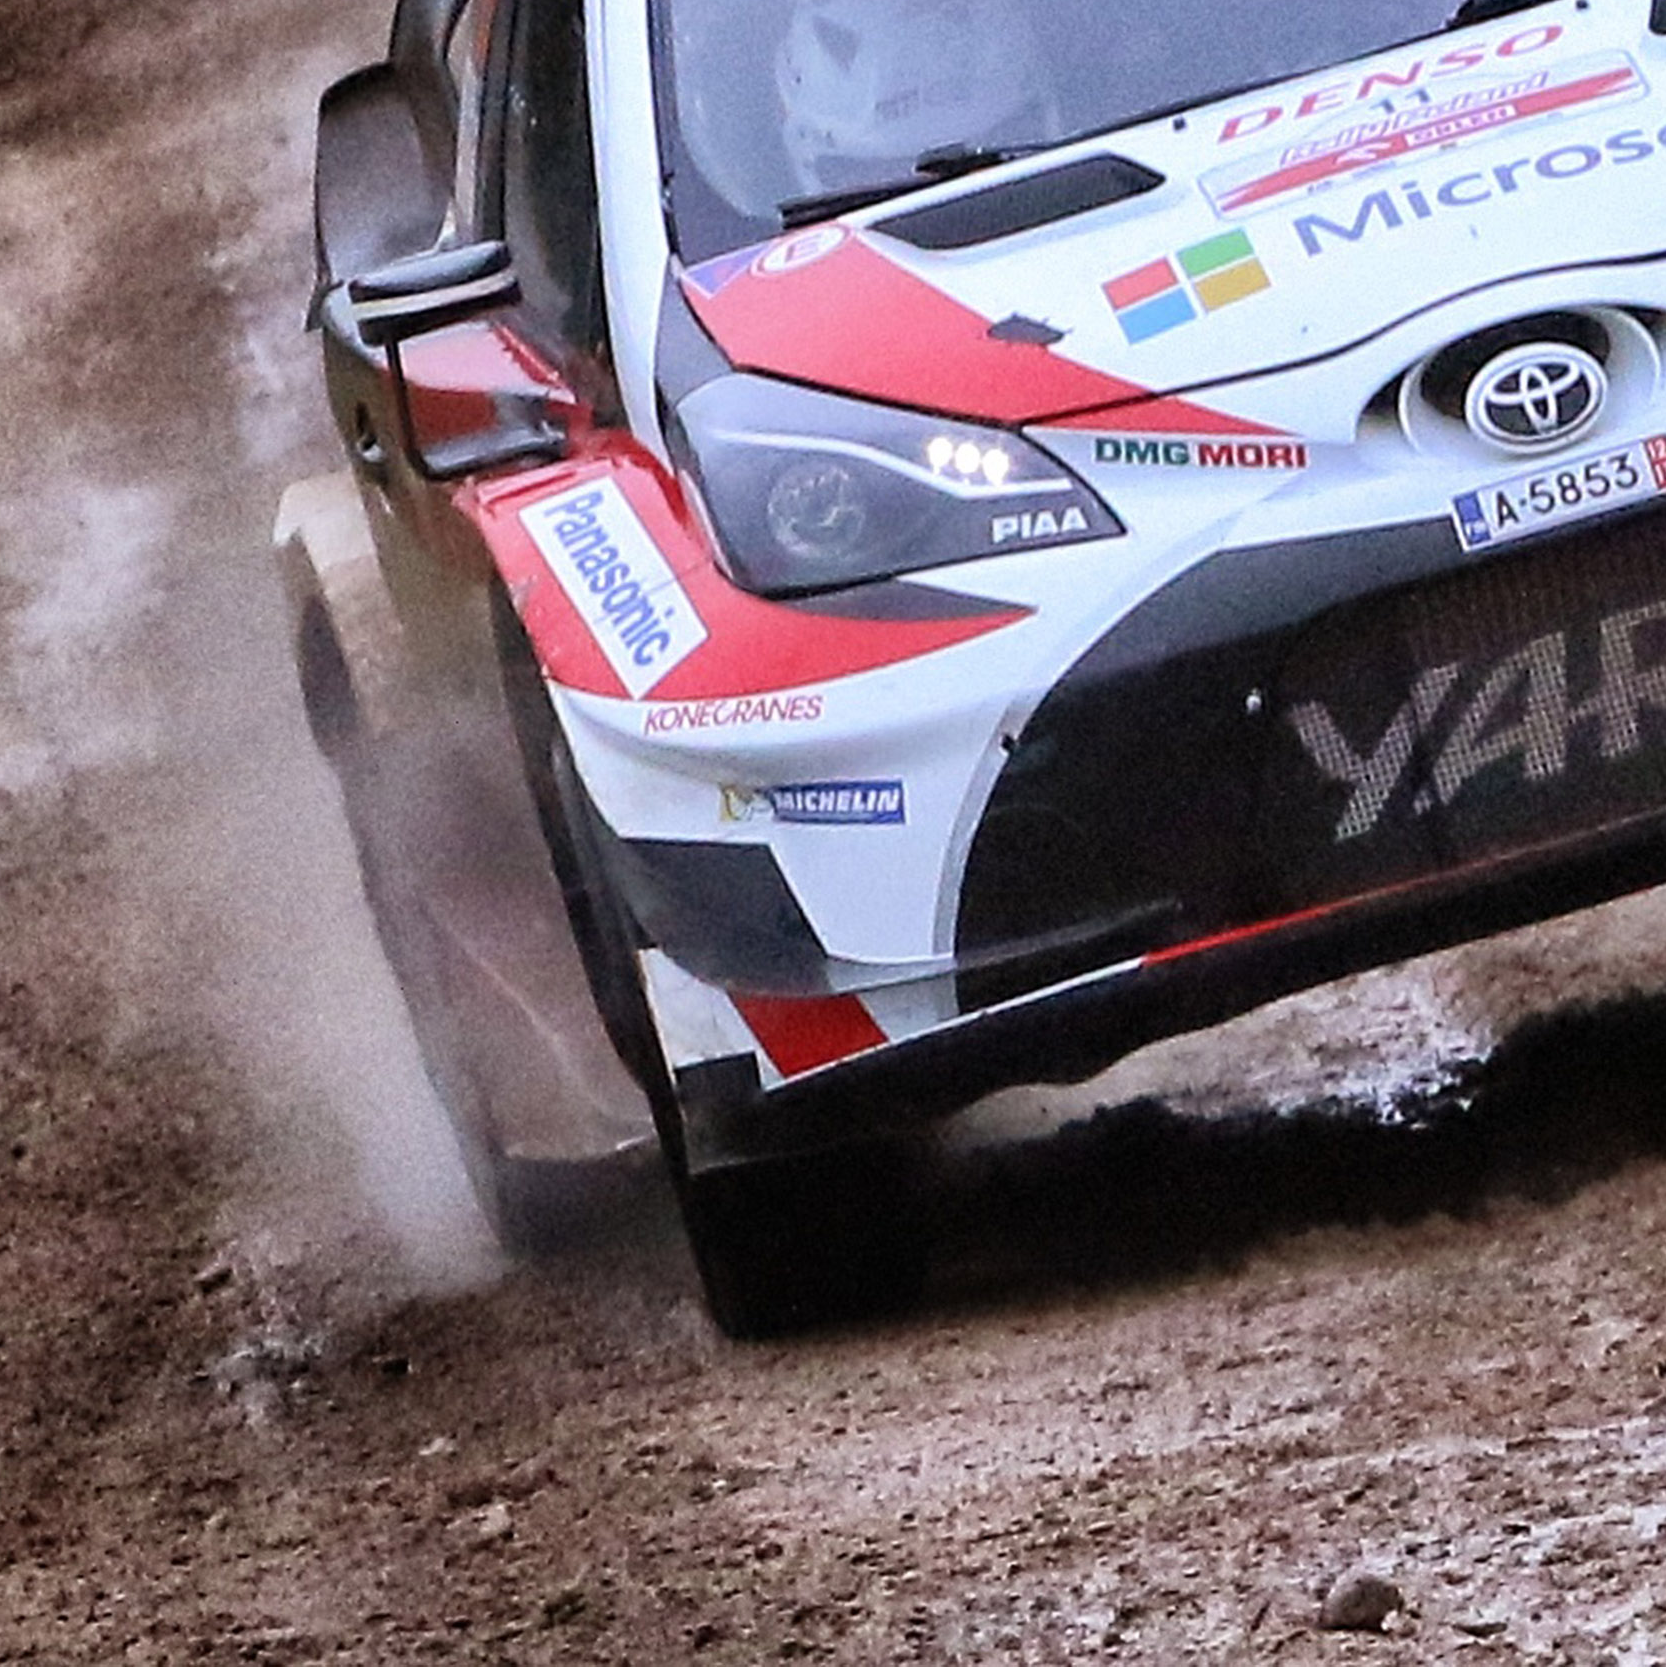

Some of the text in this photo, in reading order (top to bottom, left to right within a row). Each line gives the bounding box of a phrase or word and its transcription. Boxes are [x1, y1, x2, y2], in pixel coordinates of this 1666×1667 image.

[1217, 25, 1564, 144] DENSO
[1094, 437, 1307, 469] DMG MORI
[991, 506, 1089, 545] PIAA
[543, 490, 675, 667] Panasonic
[644, 695, 824, 735] KONECRANES
[774, 788, 900, 813] MICHELIN
